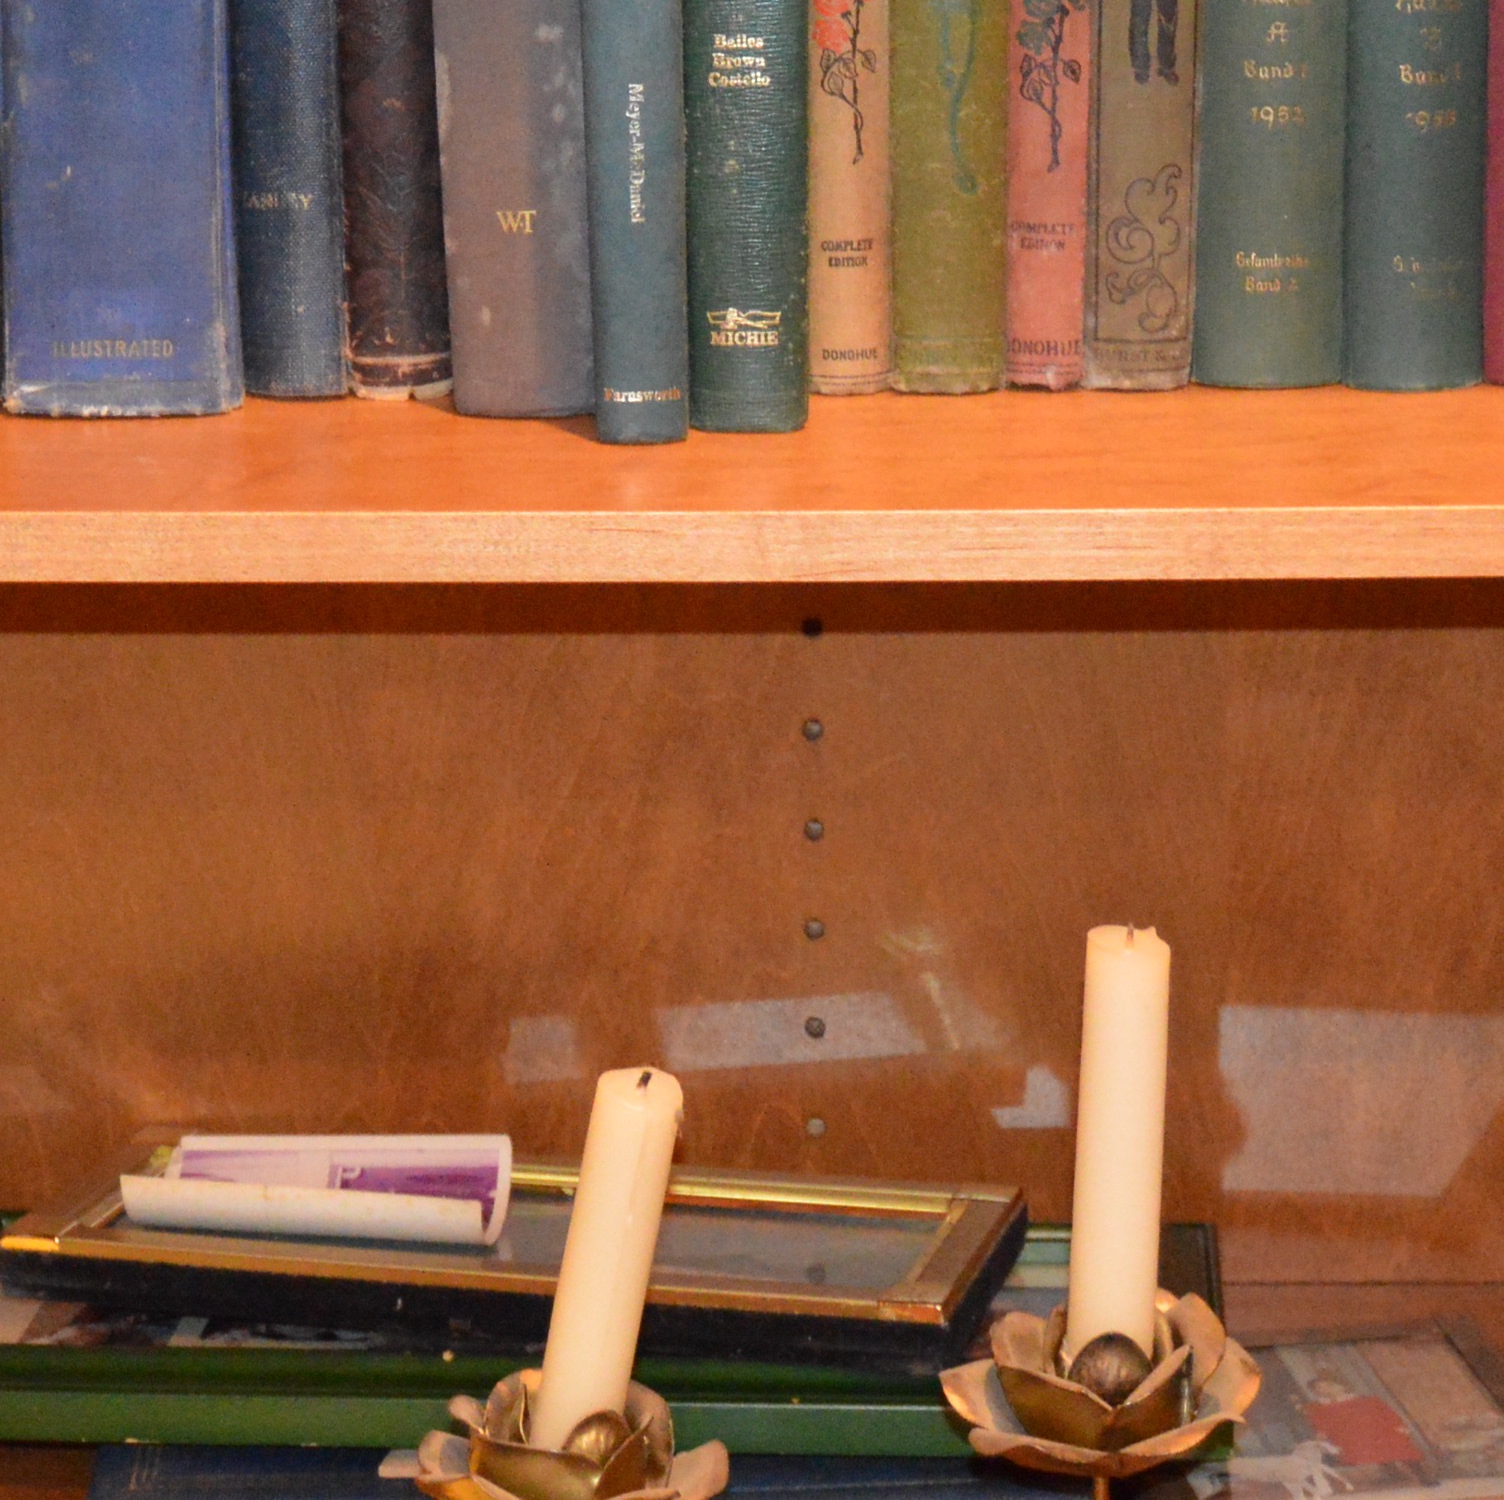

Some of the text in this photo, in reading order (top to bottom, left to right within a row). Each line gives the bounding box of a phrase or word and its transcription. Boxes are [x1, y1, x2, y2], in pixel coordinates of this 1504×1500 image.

[711, 53, 766, 69] Brown
[708, 71, 771, 88] Costello
[820, 238, 874, 253] COMPLETE
[827, 255, 869, 268] EDITION
[710, 330, 779, 347] MICHIE
[52, 339, 175, 360] ILLUSTRATED
[821, 347, 879, 362] DONOHUE
